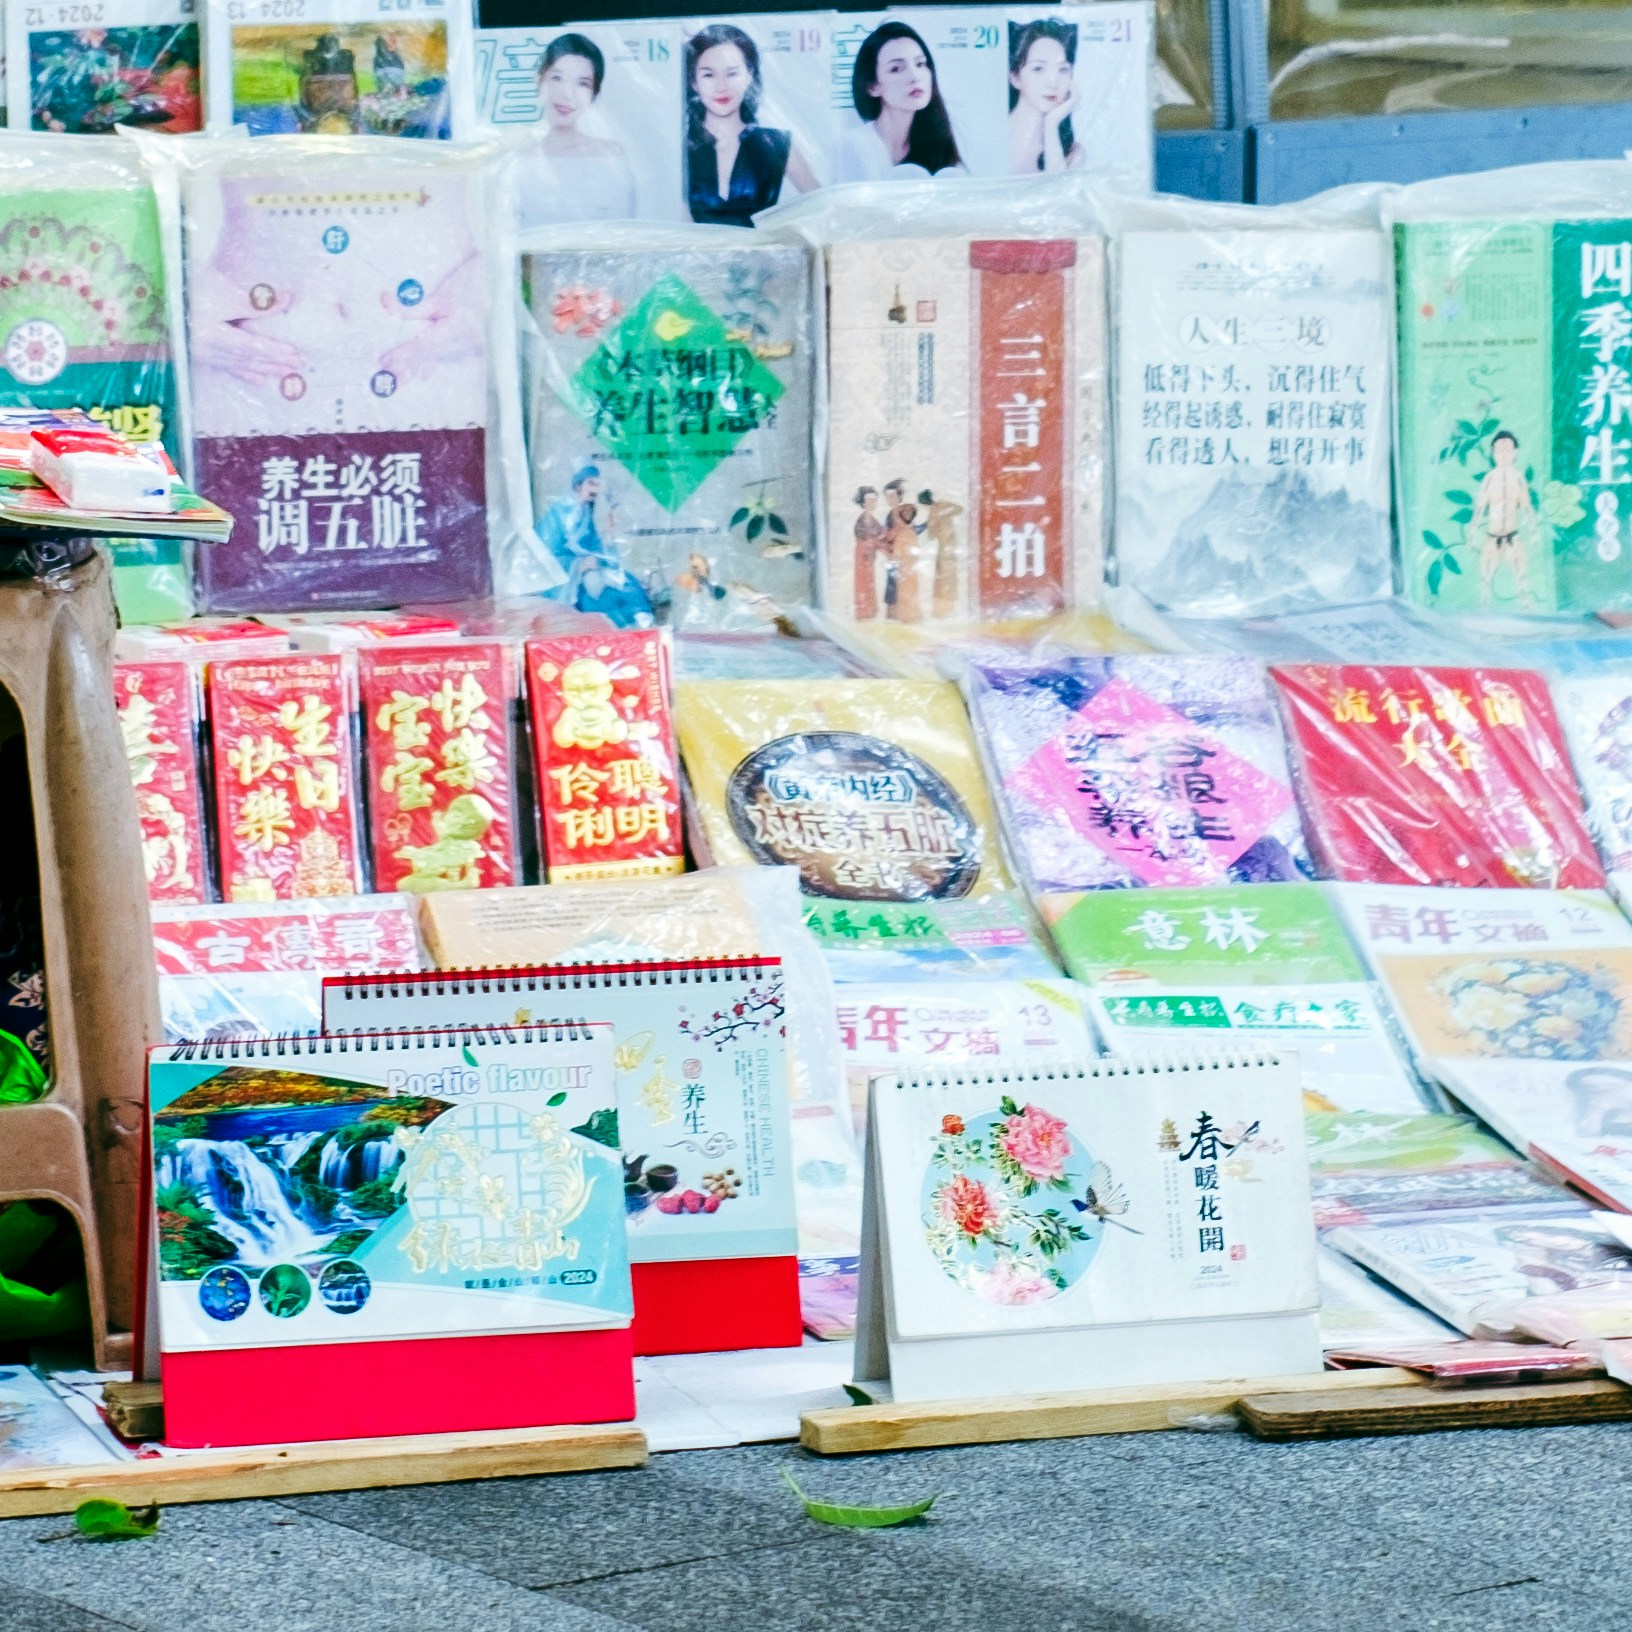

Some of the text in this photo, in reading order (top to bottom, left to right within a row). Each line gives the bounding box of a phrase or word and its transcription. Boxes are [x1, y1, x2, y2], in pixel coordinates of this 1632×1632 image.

[646, 37, 671, 63] 18
[796, 27, 822, 53] 19
[973, 25, 1000, 49] 20
[1107, 19, 1133, 43] 21
[261, 452, 422, 501] 养生必须
[993, 331, 1048, 580] 三言二拍
[254, 495, 430, 555] 调五脏
[279, 694, 340, 812] 生日
[1130, 905, 1272, 955] 意林
[386, 1063, 593, 1098] Poetic flavour
[681, 1082, 708, 1135] 养生
[1178, 1110, 1235, 1254] 春暖花開
